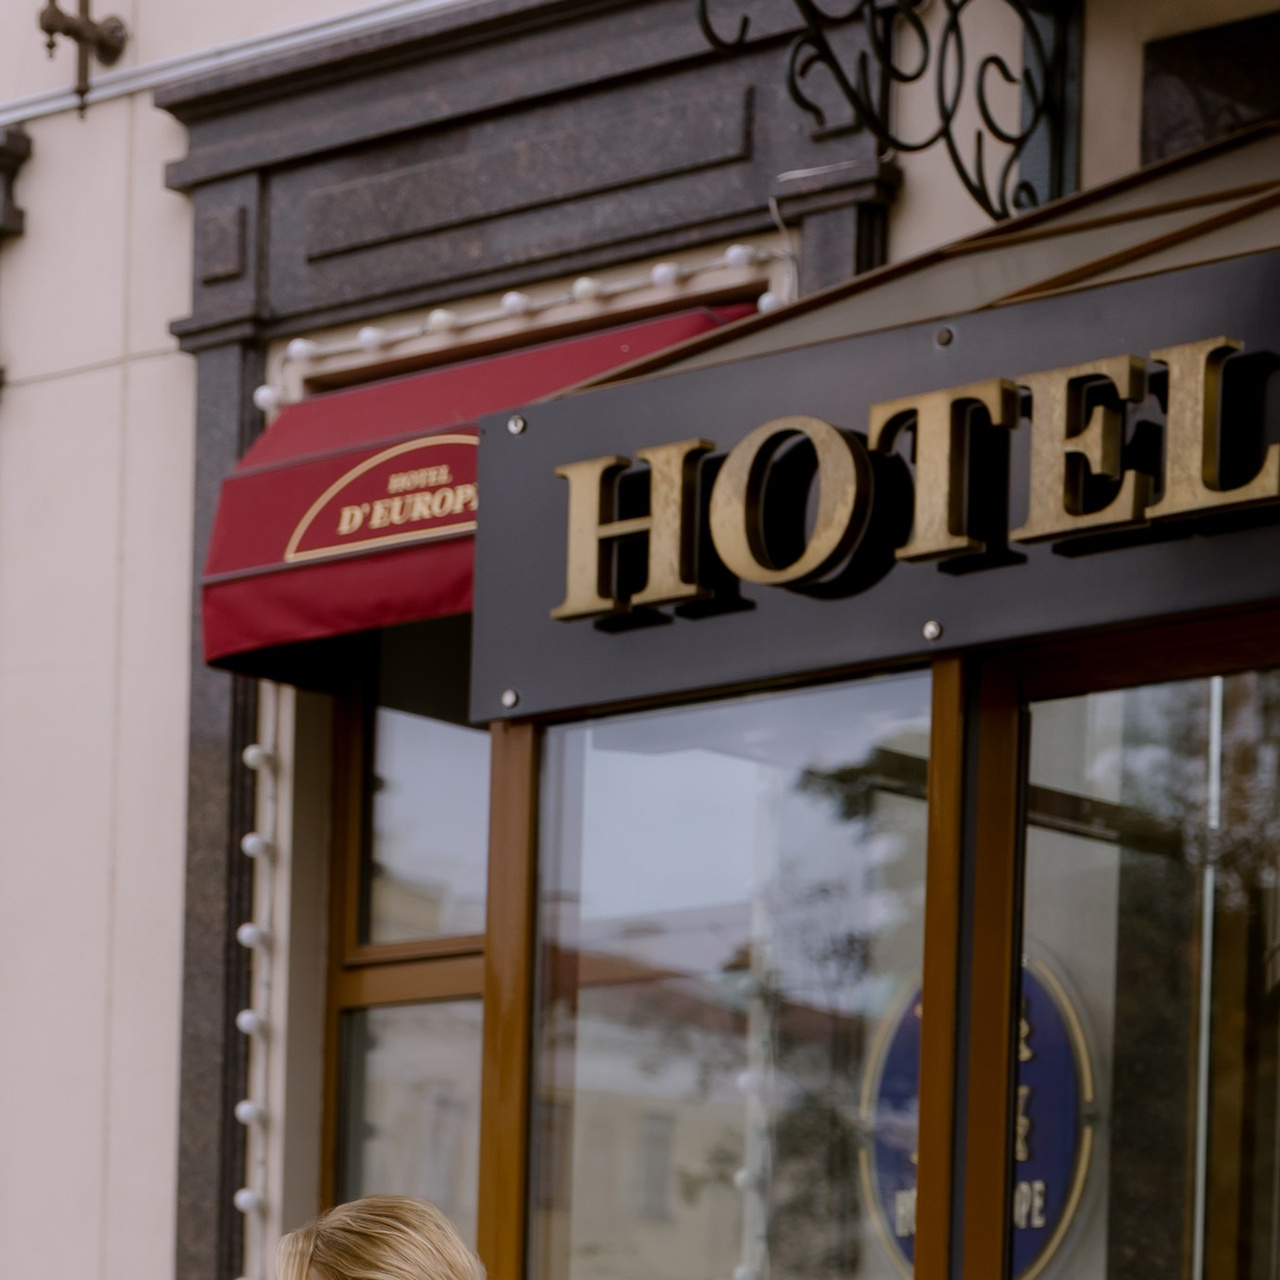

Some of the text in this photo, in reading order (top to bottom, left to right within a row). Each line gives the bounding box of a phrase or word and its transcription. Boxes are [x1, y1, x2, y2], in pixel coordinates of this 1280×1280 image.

[388, 465, 452, 493] HOTEL
[549, 334, 1280, 622] HOTEL
[337, 484, 478, 535] D'EUROP
